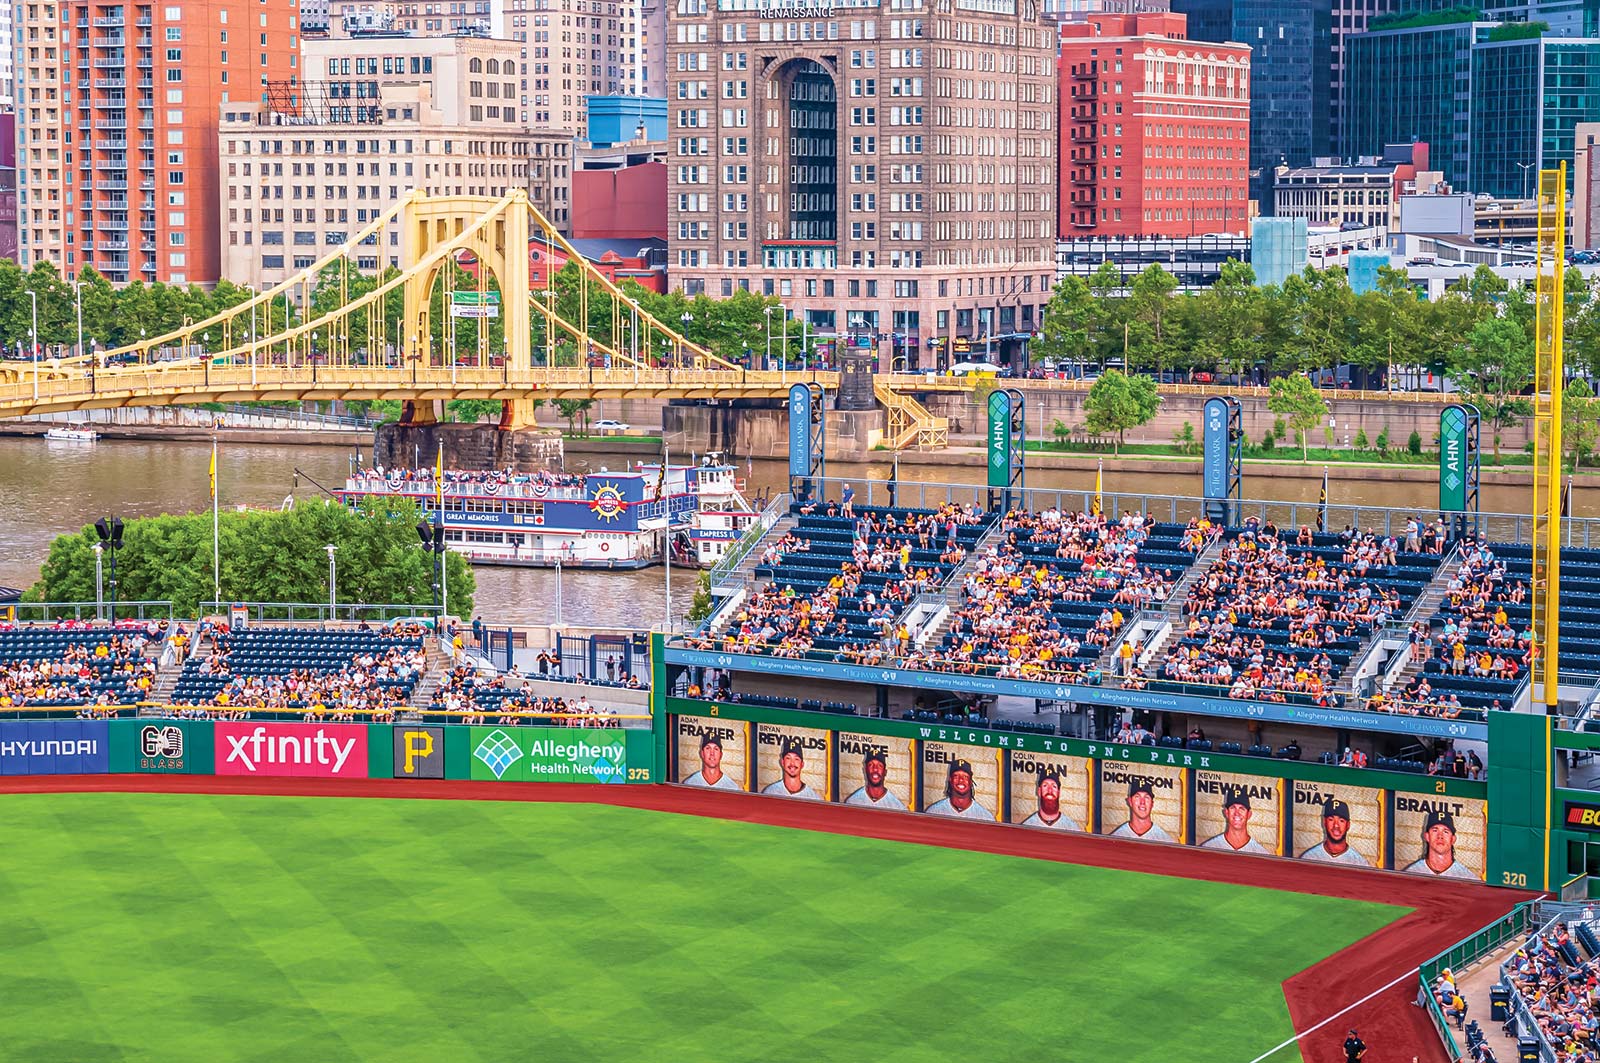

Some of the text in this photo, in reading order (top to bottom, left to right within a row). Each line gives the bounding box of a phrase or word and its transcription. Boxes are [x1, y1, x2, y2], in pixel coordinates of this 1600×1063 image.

[760, 7, 835, 19] RENAISSANCE
[993, 421, 1004, 451] AHN
[1447, 440, 1459, 472] AHN
[445, 512, 466, 520] GREAT
[467, 513, 500, 522] MEMORIES
[699, 530, 728, 538] EMPRESS
[758, 661, 784, 671] Allegheny
[802, 665, 825, 673] Network
[924, 676, 996, 689] Allegheny Health Network
[1101, 692, 1177, 706] Allegheny Health Network
[710, 705, 719, 716] 21
[680, 717, 699, 725] ADAM
[1296, 711, 1379, 725] Allegheny Health Network
[759, 725, 781, 733] BRYAN
[840, 734, 873, 744] STARLING
[1, 740, 97, 756] HYUNDAI
[225, 726, 357, 773] xfinity
[403, 730, 434, 774] P
[531, 740, 624, 761] Allegheny
[919, 727, 1210, 767] WELCOME TO PNC PARK
[925, 742, 944, 751] JOSH
[1013, 752, 1035, 761] COLIN
[140, 759, 184, 769] BLASS
[531, 763, 623, 775] Health Network
[1104, 762, 1129, 771] COREY
[628, 768, 650, 780] 375
[1198, 772, 1222, 781] KEVIN
[1295, 782, 1318, 791] ELIAS
[1435, 781, 1446, 793] 21
[1333, 801, 1340, 810] P
[1396, 797, 1464, 817] BRAULT
[1438, 813, 1445, 821] P
[1502, 871, 1527, 887] 320
